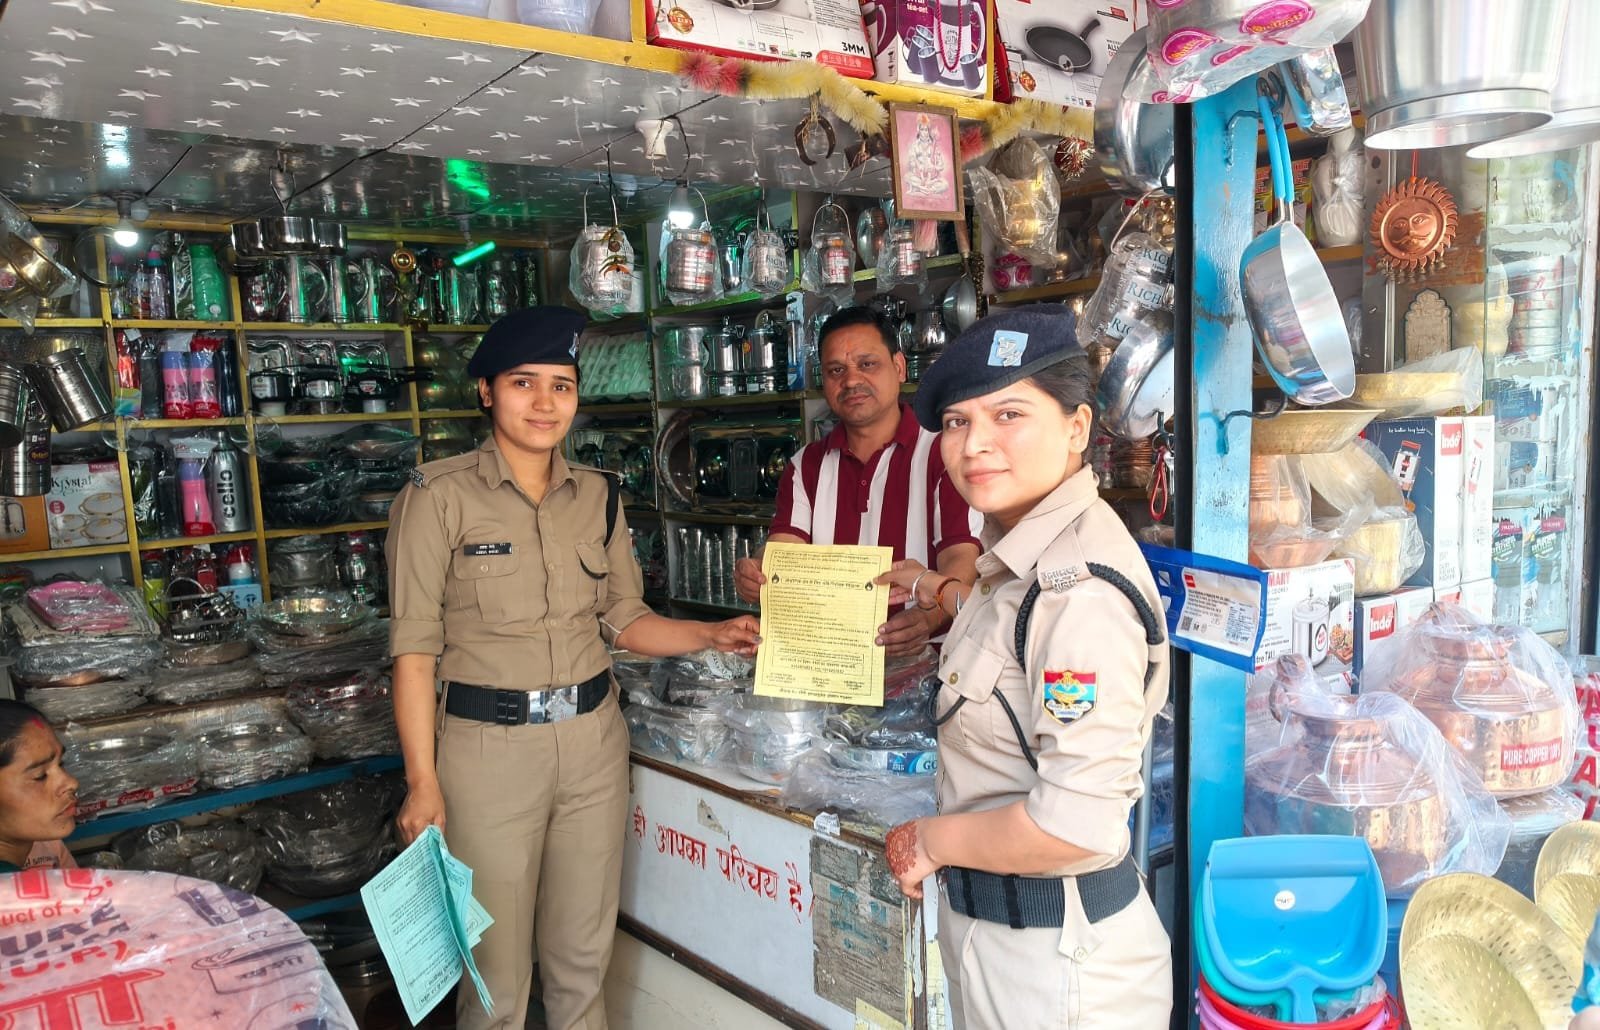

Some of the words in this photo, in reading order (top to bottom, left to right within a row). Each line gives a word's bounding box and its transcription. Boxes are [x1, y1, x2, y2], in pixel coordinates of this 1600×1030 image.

[841, 41, 865, 55] 3MM
[1127, 281, 1162, 305] RICH
[217, 470, 236, 518] cello
[1503, 749, 1523, 766] PURE
[1524, 744, 1549, 764] COPPER
[655, 822, 707, 870] आपका
[716, 844, 779, 899] परिचय
[42, 902, 62, 919] of
